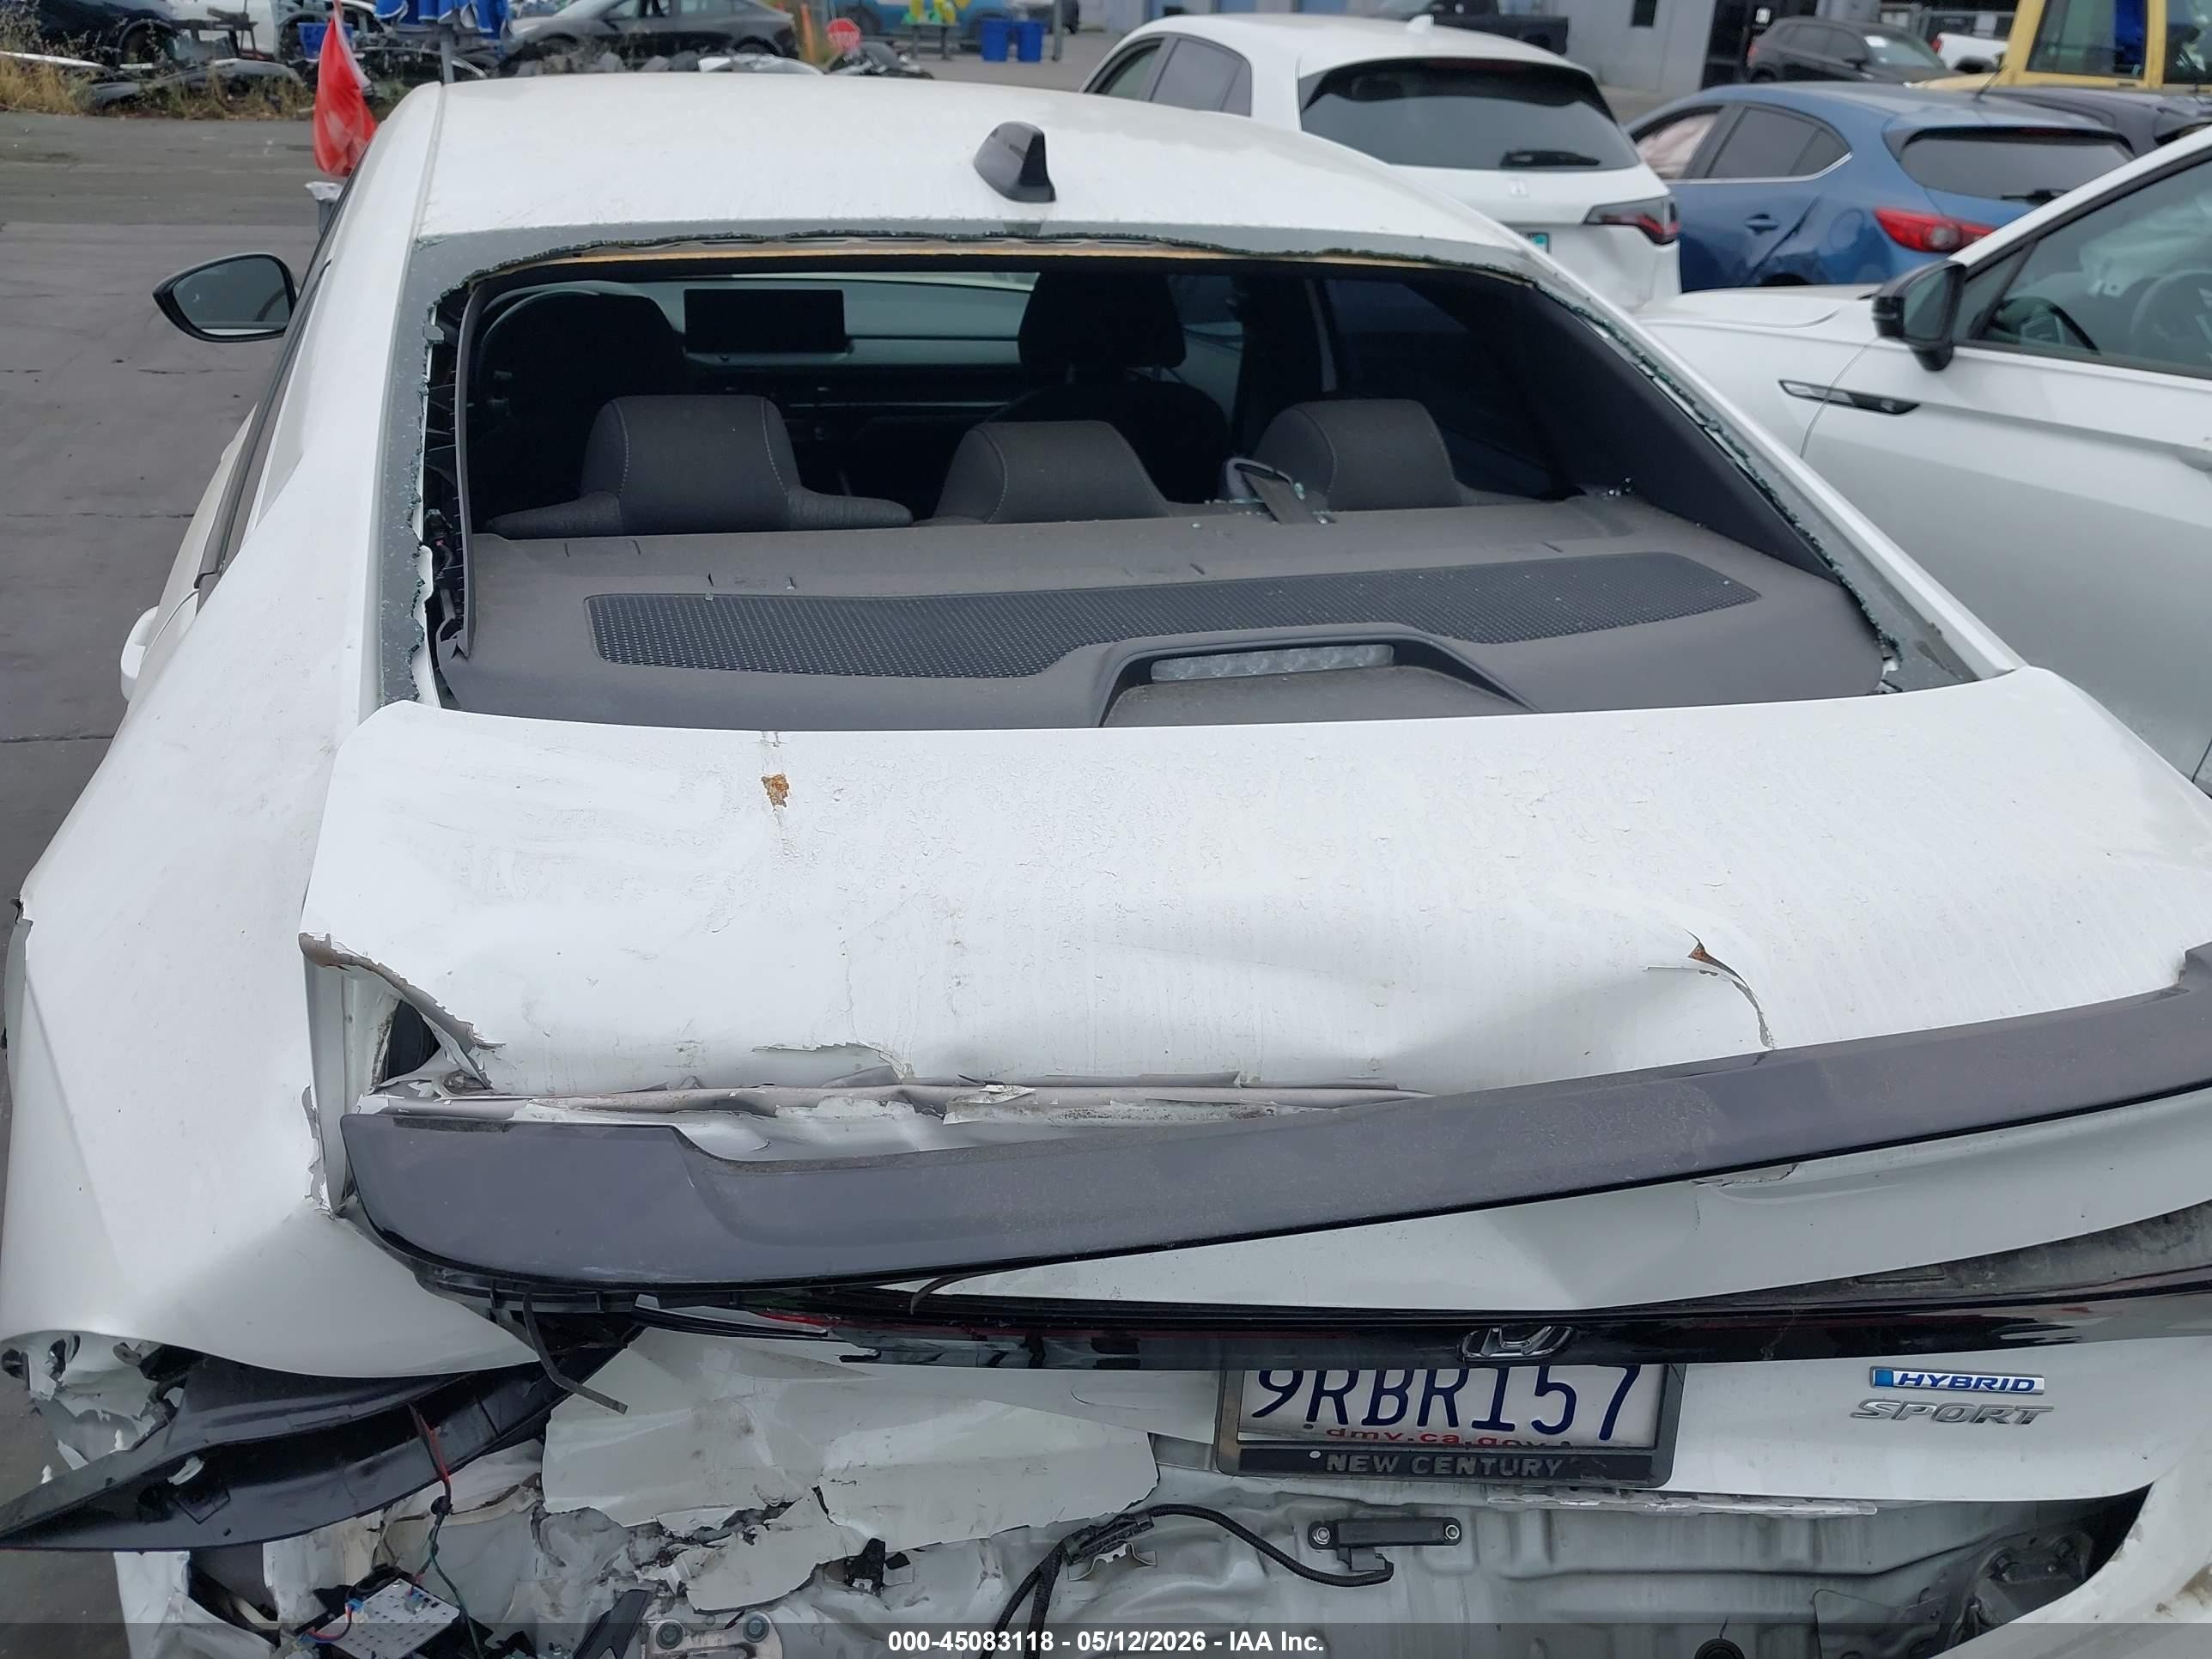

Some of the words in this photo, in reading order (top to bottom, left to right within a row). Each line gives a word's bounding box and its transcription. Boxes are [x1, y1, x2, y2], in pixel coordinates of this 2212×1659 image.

[1898, 1372, 2035, 1392] HYBRID
[1251, 1364, 1641, 1441] 9RBR157
[1850, 1398, 2055, 1425] SPORT
[1326, 1454, 1400, 1473] NEW
[1411, 1455, 1564, 1477] CENTURY
